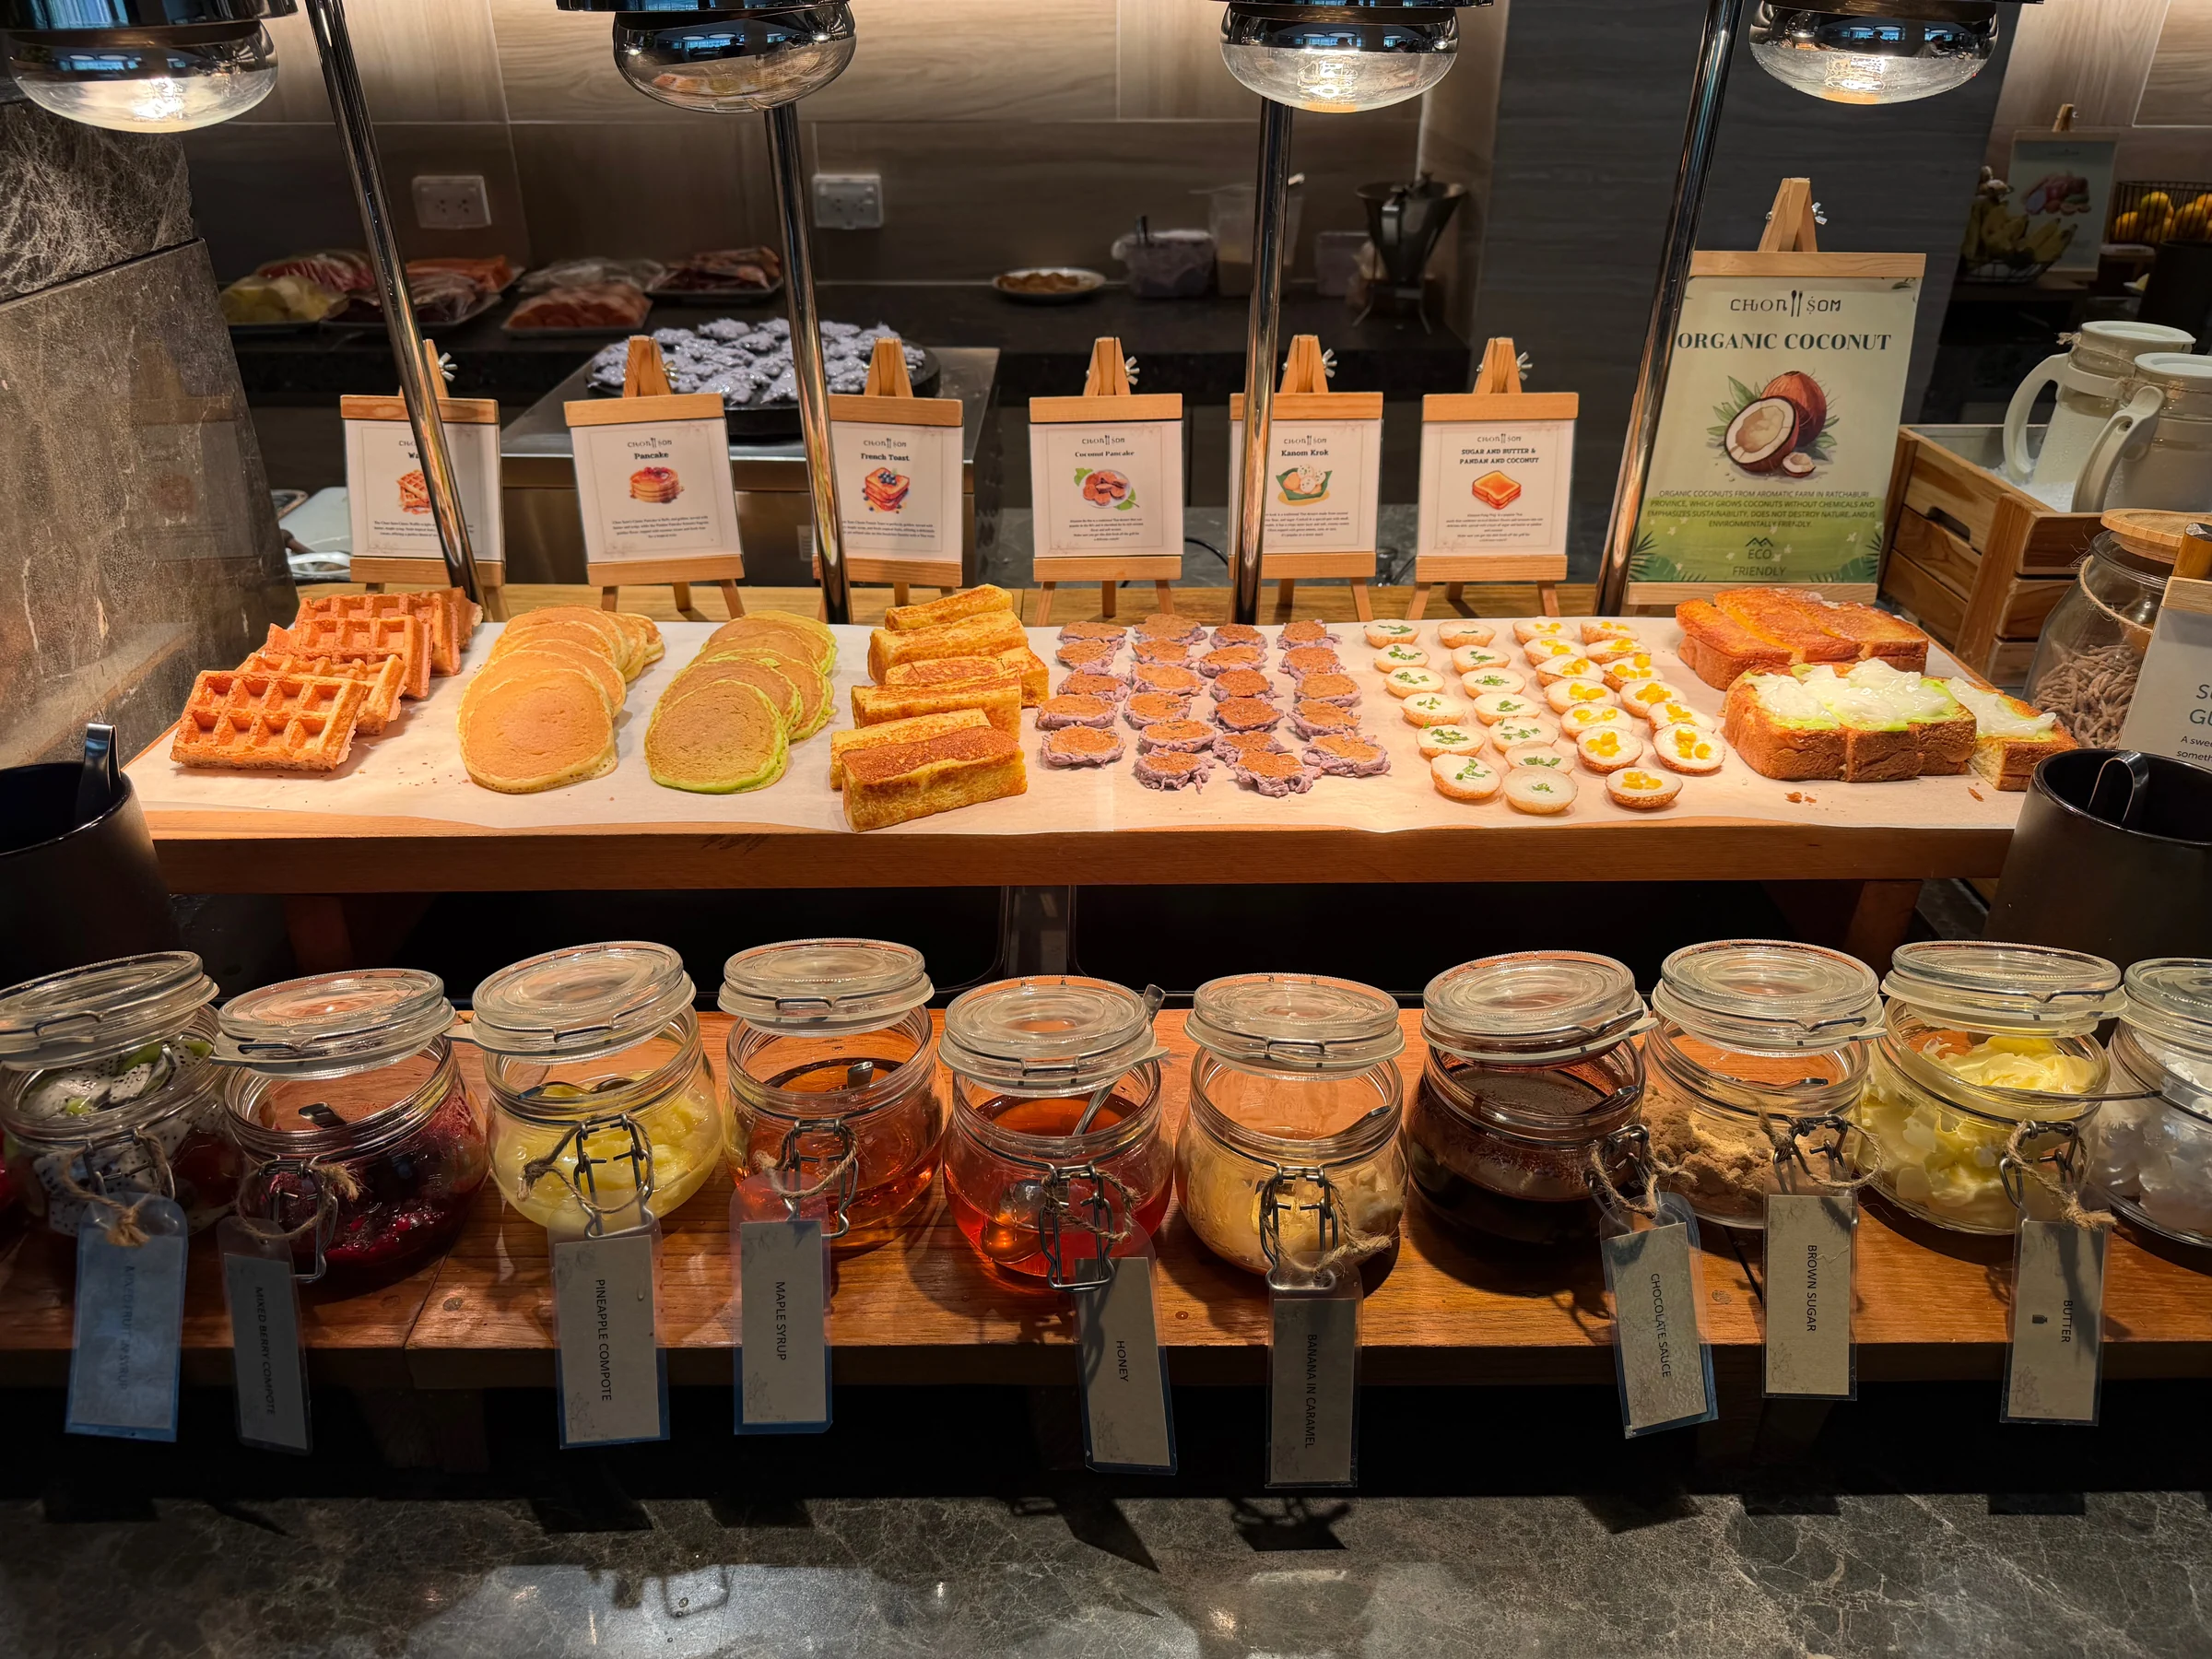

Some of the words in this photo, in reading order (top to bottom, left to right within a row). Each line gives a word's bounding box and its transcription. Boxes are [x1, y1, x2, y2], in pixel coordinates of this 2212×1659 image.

[1677, 332, 1778, 350] ORGANIC
[1784, 331, 1892, 351] COCONUT
[633, 451, 670, 461] Pancake
[860, 452, 887, 461] French
[888, 453, 911, 462] Toast
[1105, 449, 1135, 457] Pancake
[1281, 449, 1309, 457] Kanom
[1310, 448, 1330, 456] Krok
[1459, 457, 1489, 465] PANDAN
[1506, 456, 1540, 465] COCONUT
[1650, 500, 1688, 508] PROVINCE,
[1689, 500, 1714, 508] WHICH
[1715, 500, 1742, 508] GROWS
[1659, 489, 1692, 498] ORGANIC
[1693, 489, 1733, 498] COCONUTS
[1735, 489, 1756, 498] FROM
[1756, 489, 1794, 498] AROMATIC
[1825, 490, 1870, 499] RATCHABURI
[1647, 510, 1690, 518] EMPHASIZES
[1708, 520, 1776, 528] ENVIRONMENTALLY
[1732, 566, 1787, 576] FRIENDLY
[1747, 548, 1771, 560] ECO
[2180, 735, 2188, 744] A
[1806, 1244, 1818, 1289] BROWN
[254, 1286, 267, 1323] MIXED
[594, 1279, 608, 1340] PINEAPPLE
[775, 1281, 786, 1321] MAPLE
[1651, 1273, 1667, 1339] CHOCOLATE
[1806, 1292, 1817, 1332] SUGAR
[2061, 1300, 2074, 1343] BUTTER
[258, 1324, 271, 1359] BERRY
[776, 1324, 787, 1361] SYRUP
[1306, 1334, 1318, 1380] BANANA
[598, 1343, 612, 1402] COMPOTE
[1115, 1340, 1129, 1382] HONEY
[1658, 1341, 1672, 1378] SAUCE
[262, 1361, 276, 1418] COMPOTE
[1306, 1382, 1316, 1394] IN
[1304, 1397, 1316, 1450] CARAMEL
